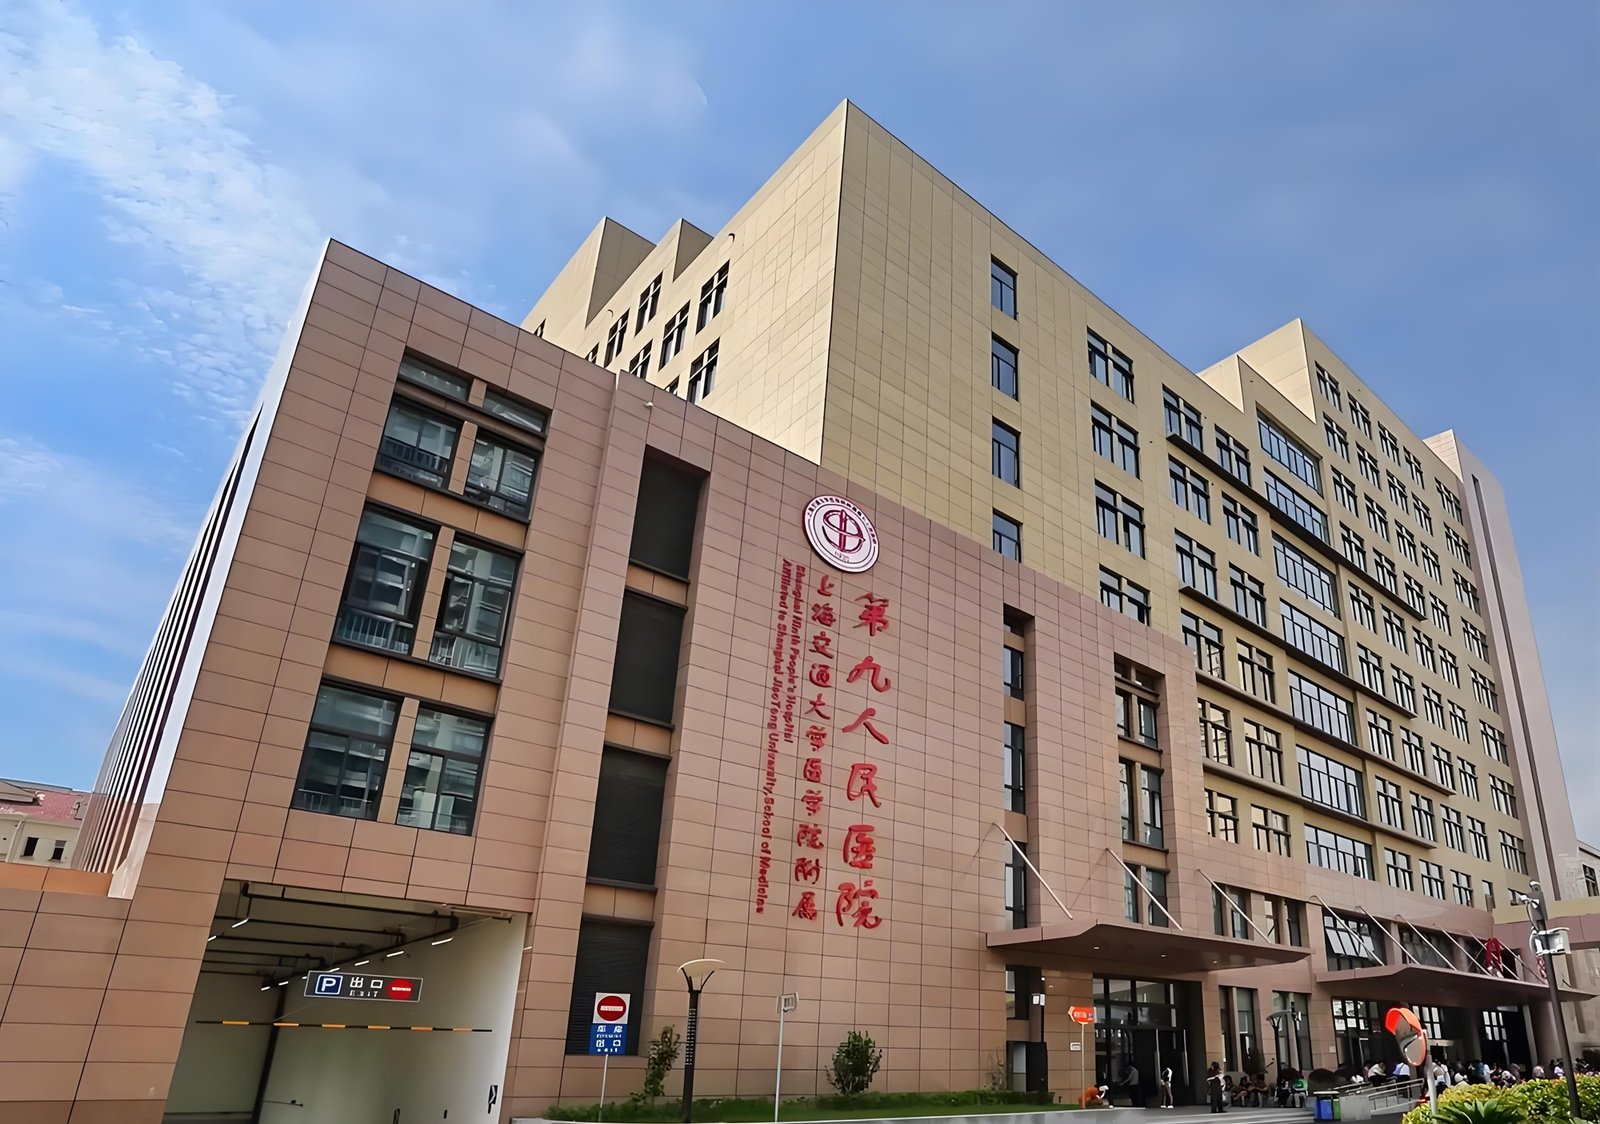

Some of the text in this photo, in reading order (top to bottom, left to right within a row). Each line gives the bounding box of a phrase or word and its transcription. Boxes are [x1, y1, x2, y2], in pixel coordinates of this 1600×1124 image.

[792, 564, 806, 614] Shanghai
[777, 610, 787, 621] to
[791, 614, 803, 646] Ninth
[773, 623, 787, 675] Shanghai
[783, 694, 797, 743] Hospital
[836, 592, 891, 929] 第九人民医院
[760, 841, 771, 855] of
[756, 855, 771, 914] Medicine
[321, 977, 336, 991] P
[349, 977, 383, 989] 出口
